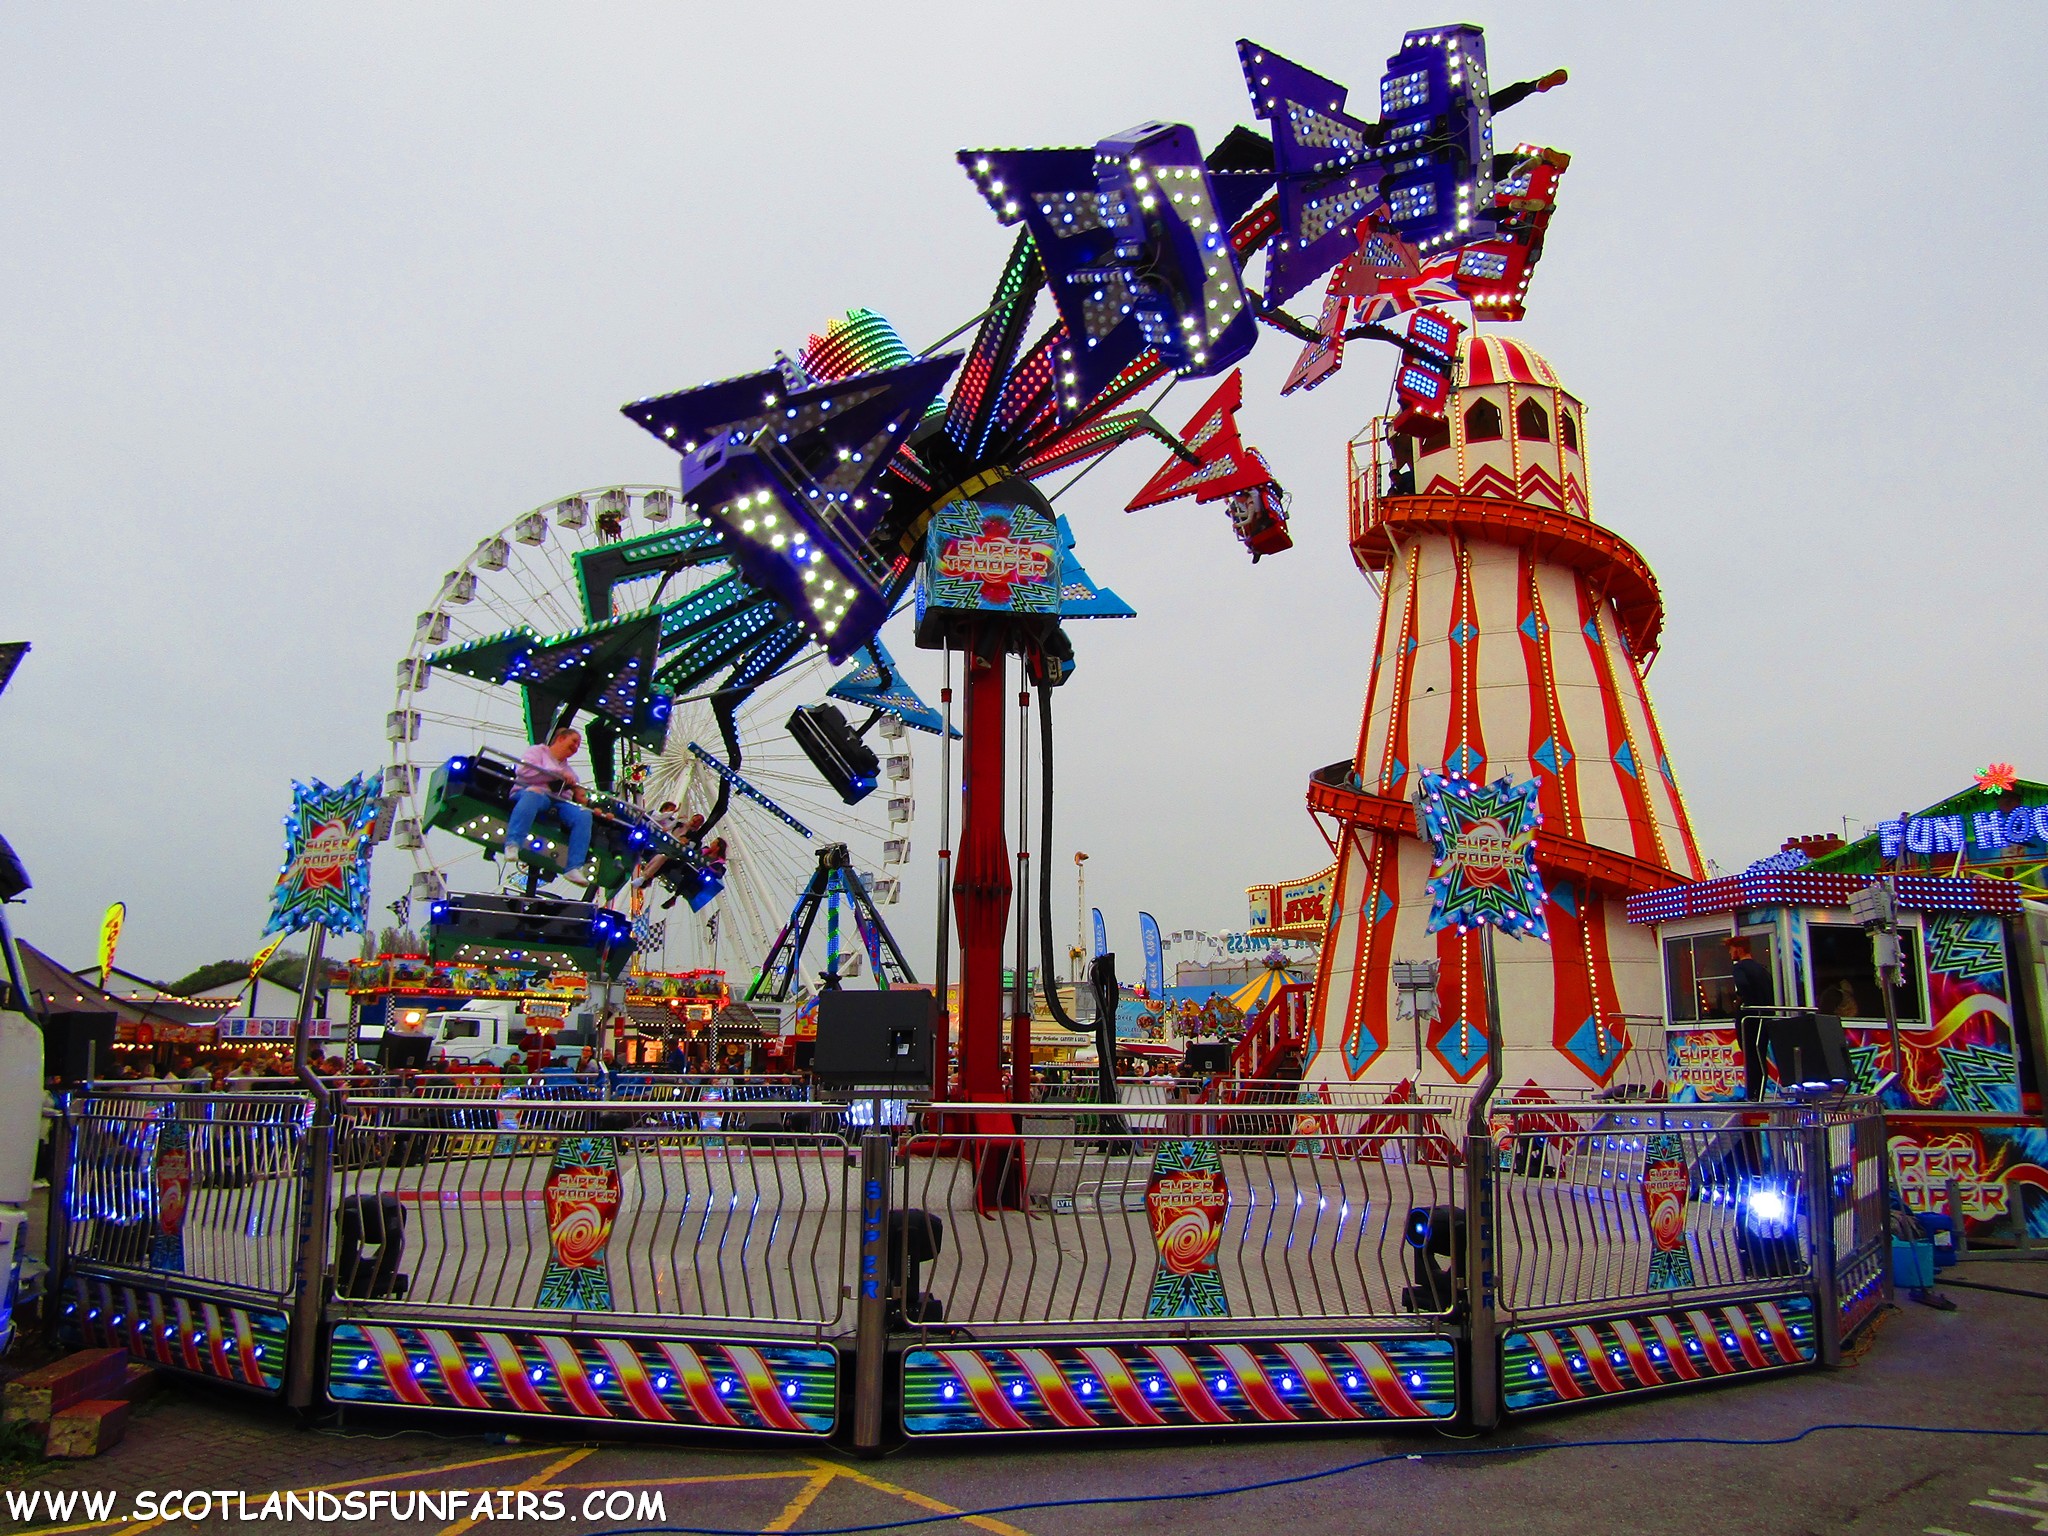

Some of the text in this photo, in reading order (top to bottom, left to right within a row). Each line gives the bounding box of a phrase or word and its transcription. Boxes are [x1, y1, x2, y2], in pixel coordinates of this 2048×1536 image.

[958, 541, 1033, 560] SUPER
[943, 556, 1048, 577] TROOPER
[1456, 835, 1513, 850] SUPER
[1877, 814, 1966, 857] FUN
[305, 839, 350, 850] SUPER
[295, 852, 357, 867] TROOPER
[1447, 851, 1525, 868] TROOPER
[1285, 882, 1326, 899] HAVE A
[1679, 1047, 1734, 1065] SUPER
[1671, 1066, 1746, 1086] TROOPER
[1897, 1150, 1975, 1178] PER
[558, 1174, 608, 1189] SUPER
[1650, 1169, 1680, 1179] SUPER
[1160, 1180, 1214, 1193] SUPER
[1644, 1180, 1687, 1191] TROOPER
[549, 1187, 617, 1203] TROOPER
[1150, 1193, 1224, 1206] TROOPER
[862, 1180, 882, 1299] SUPER
